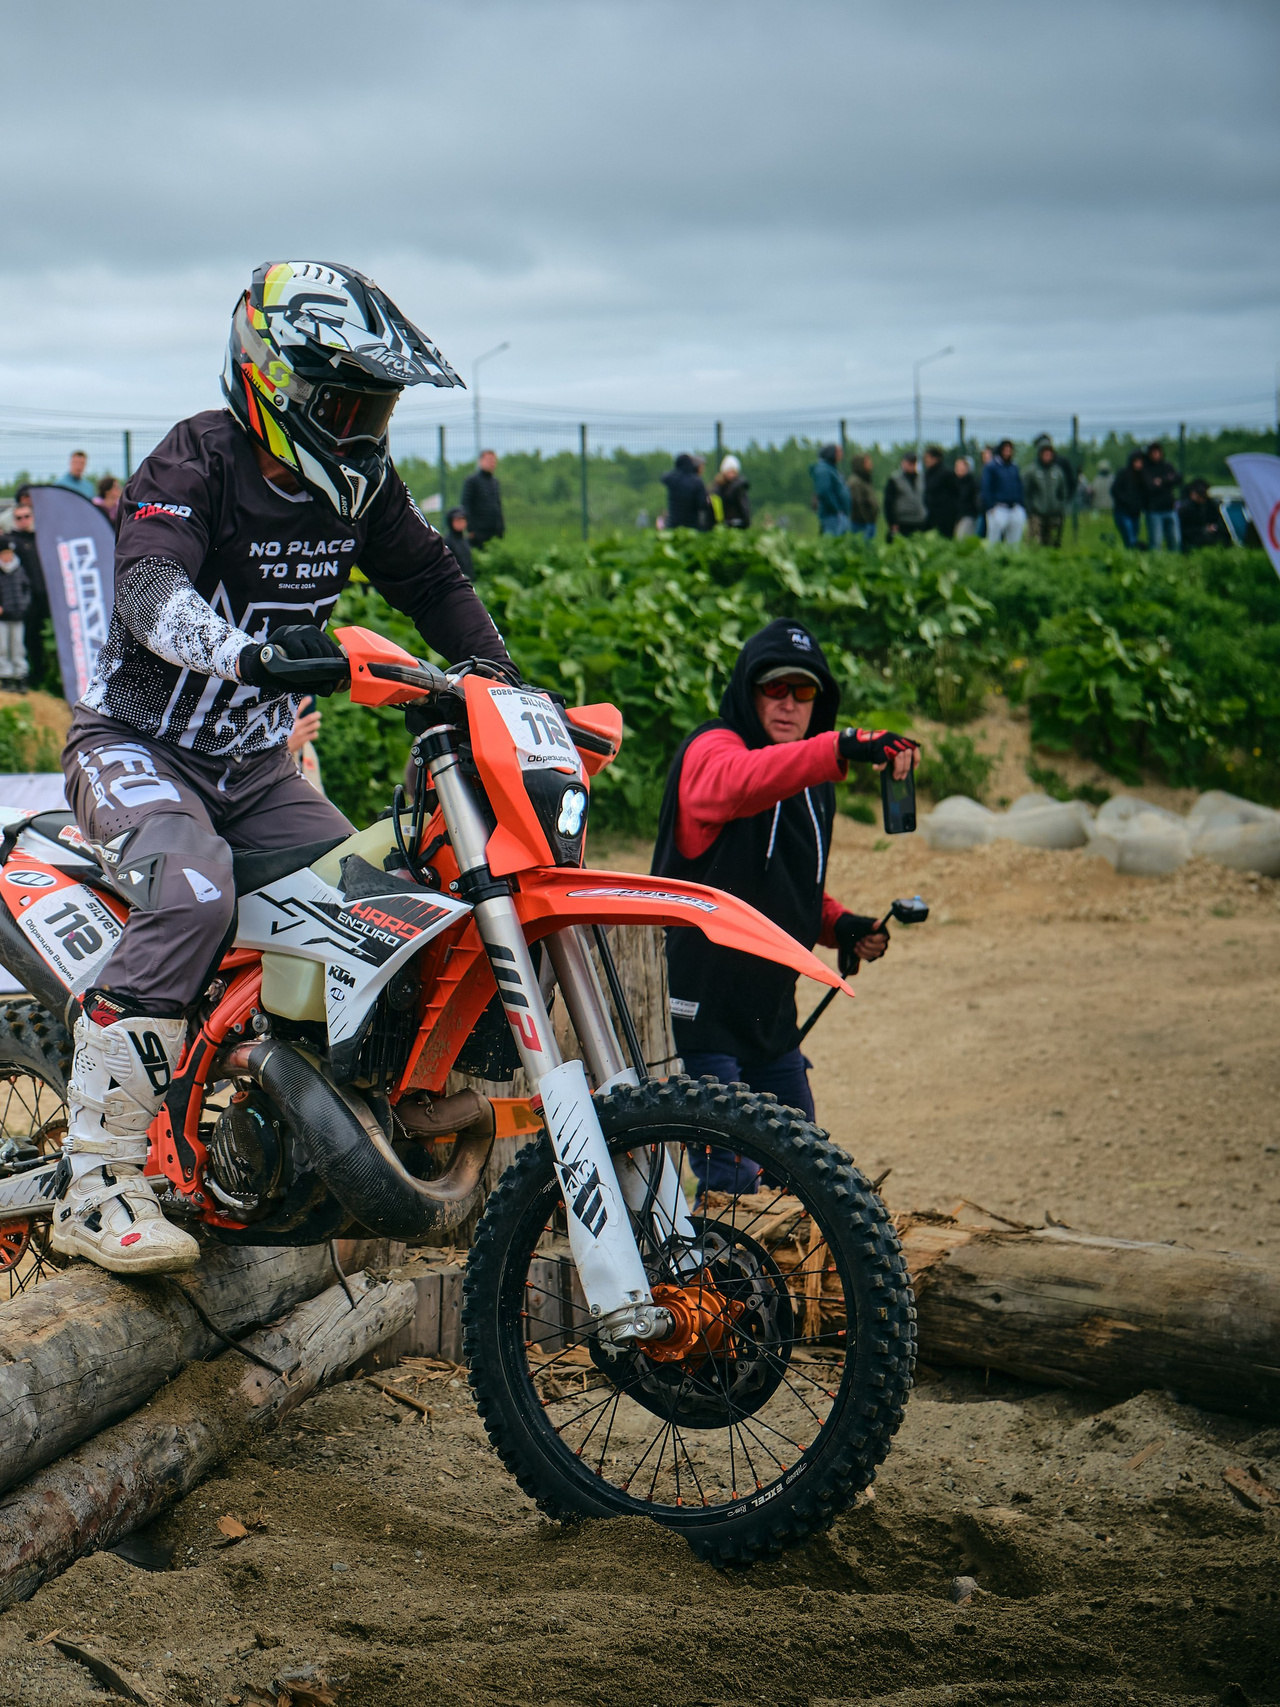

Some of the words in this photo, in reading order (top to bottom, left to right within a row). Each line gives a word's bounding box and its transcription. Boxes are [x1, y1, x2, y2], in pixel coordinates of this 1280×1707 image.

[249, 541, 281, 557] NO
[259, 562, 288, 578] TO
[295, 560, 339, 578] RUN
[520, 711, 571, 750] 112
[44, 901, 103, 961] 112
[336, 911, 401, 947] ENDURO
[350, 902, 424, 940] HARD
[25, 918, 55, 956] Образцов
[53, 953, 75, 981] Вадим
[328, 964, 356, 988] KTM
[751, 1483, 784, 1507] EXCEL
